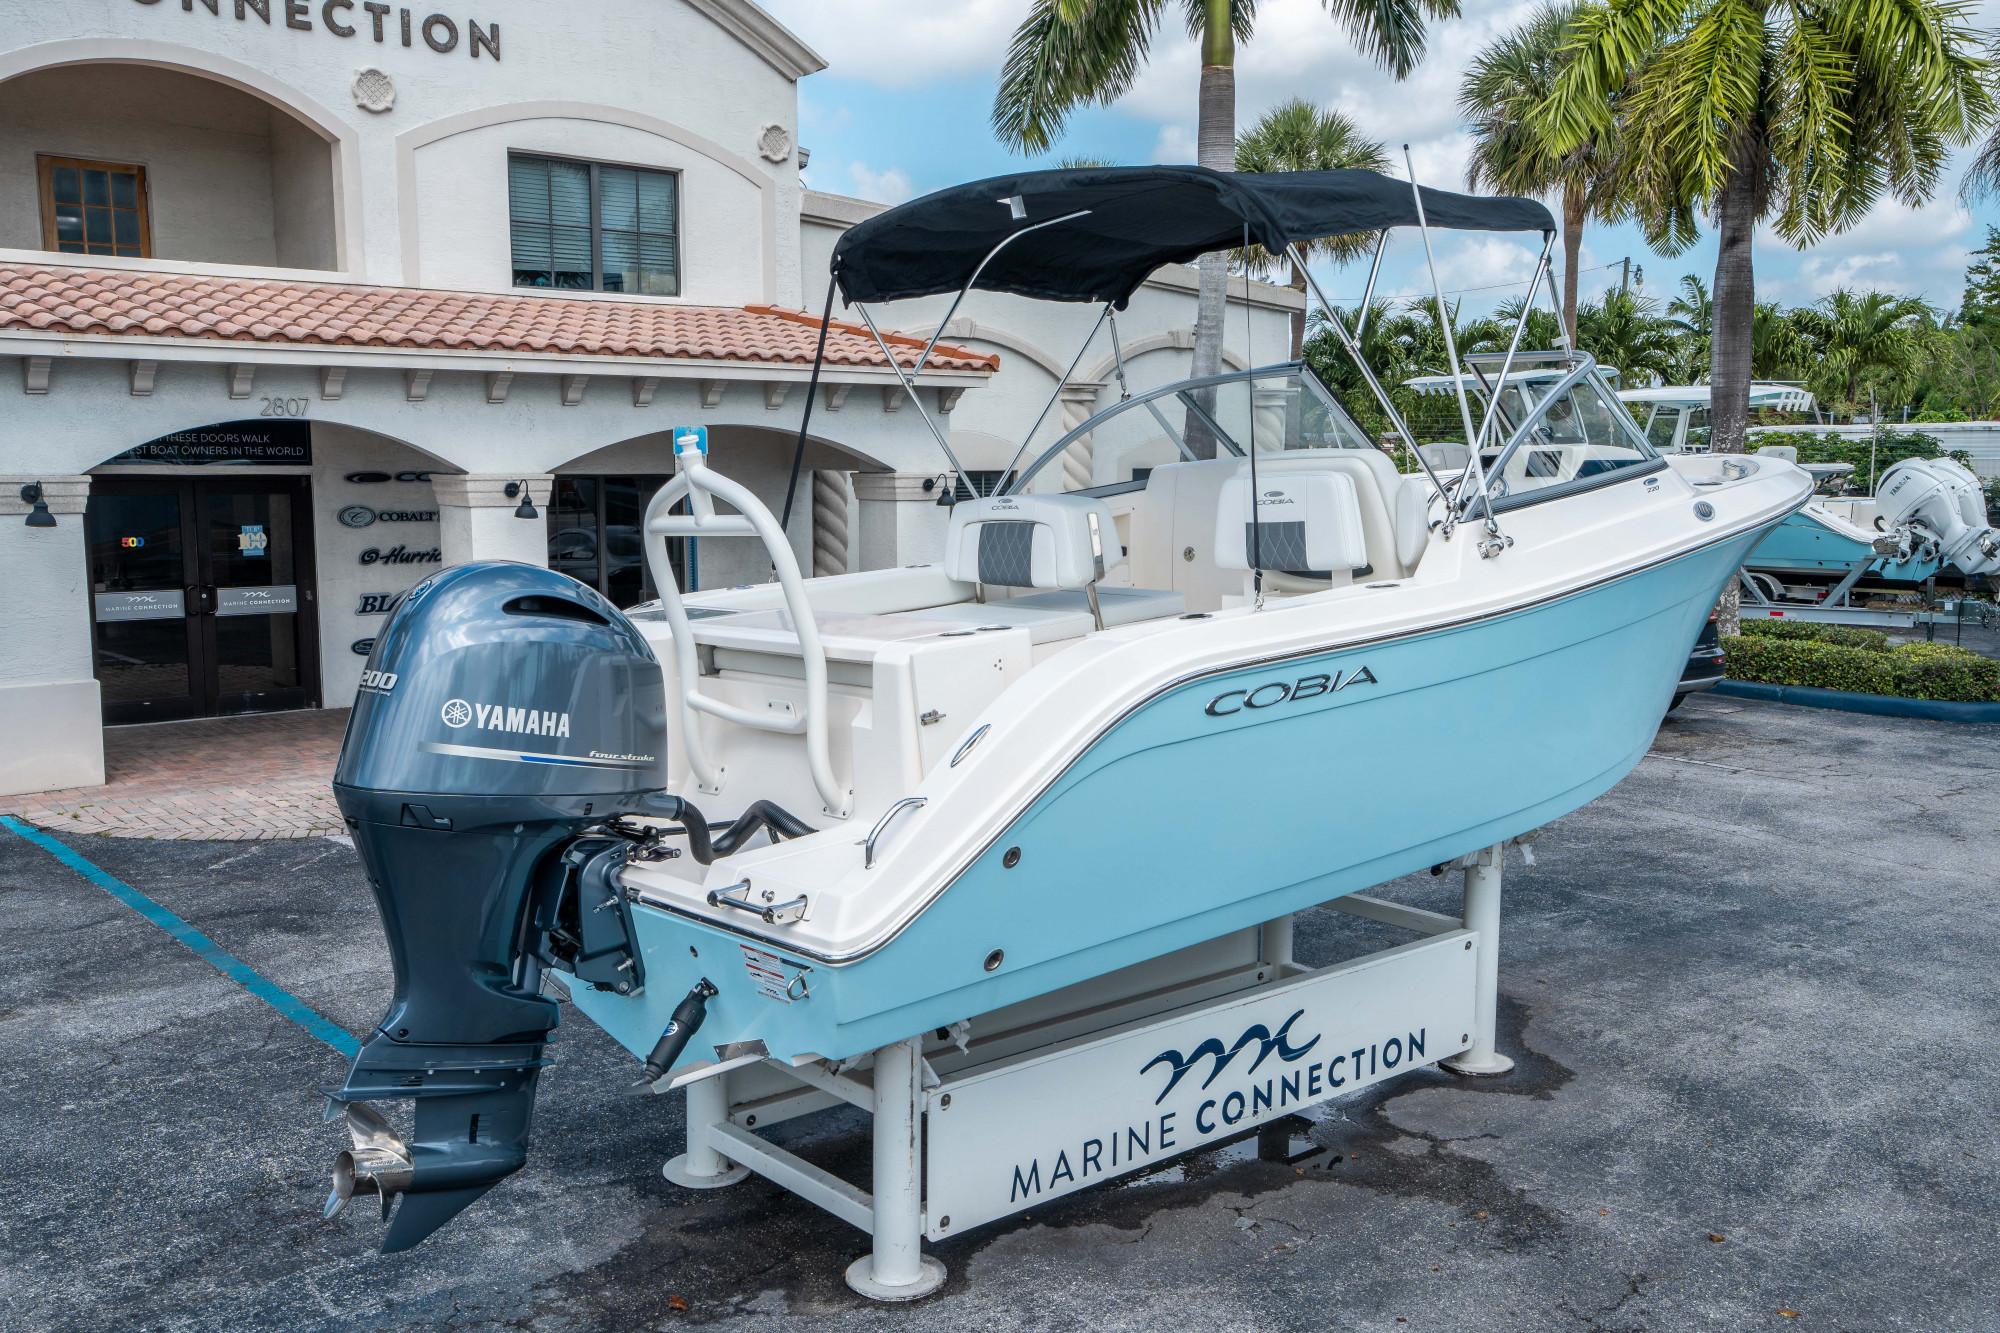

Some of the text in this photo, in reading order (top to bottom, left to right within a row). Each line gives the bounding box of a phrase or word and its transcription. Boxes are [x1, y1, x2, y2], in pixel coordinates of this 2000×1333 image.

[260, 397, 311, 416] 2807
[200, 433, 240, 443] DOORS
[242, 434, 270, 444] WALK
[150, 445, 179, 456] BOAT
[181, 445, 229, 456] OWNERS
[230, 446, 242, 456] IN
[243, 446, 264, 457] THE
[264, 446, 304, 457] WORLD
[121, 536, 145, 548] 500
[133, 603, 178, 611] CONNECTION
[249, 598, 291, 606] CONNECTION
[1204, 665, 1378, 716] COBIA
[475, 703, 570, 738] YAMAHA
[1010, 1027, 1427, 1203] MARINE CONNECTION
